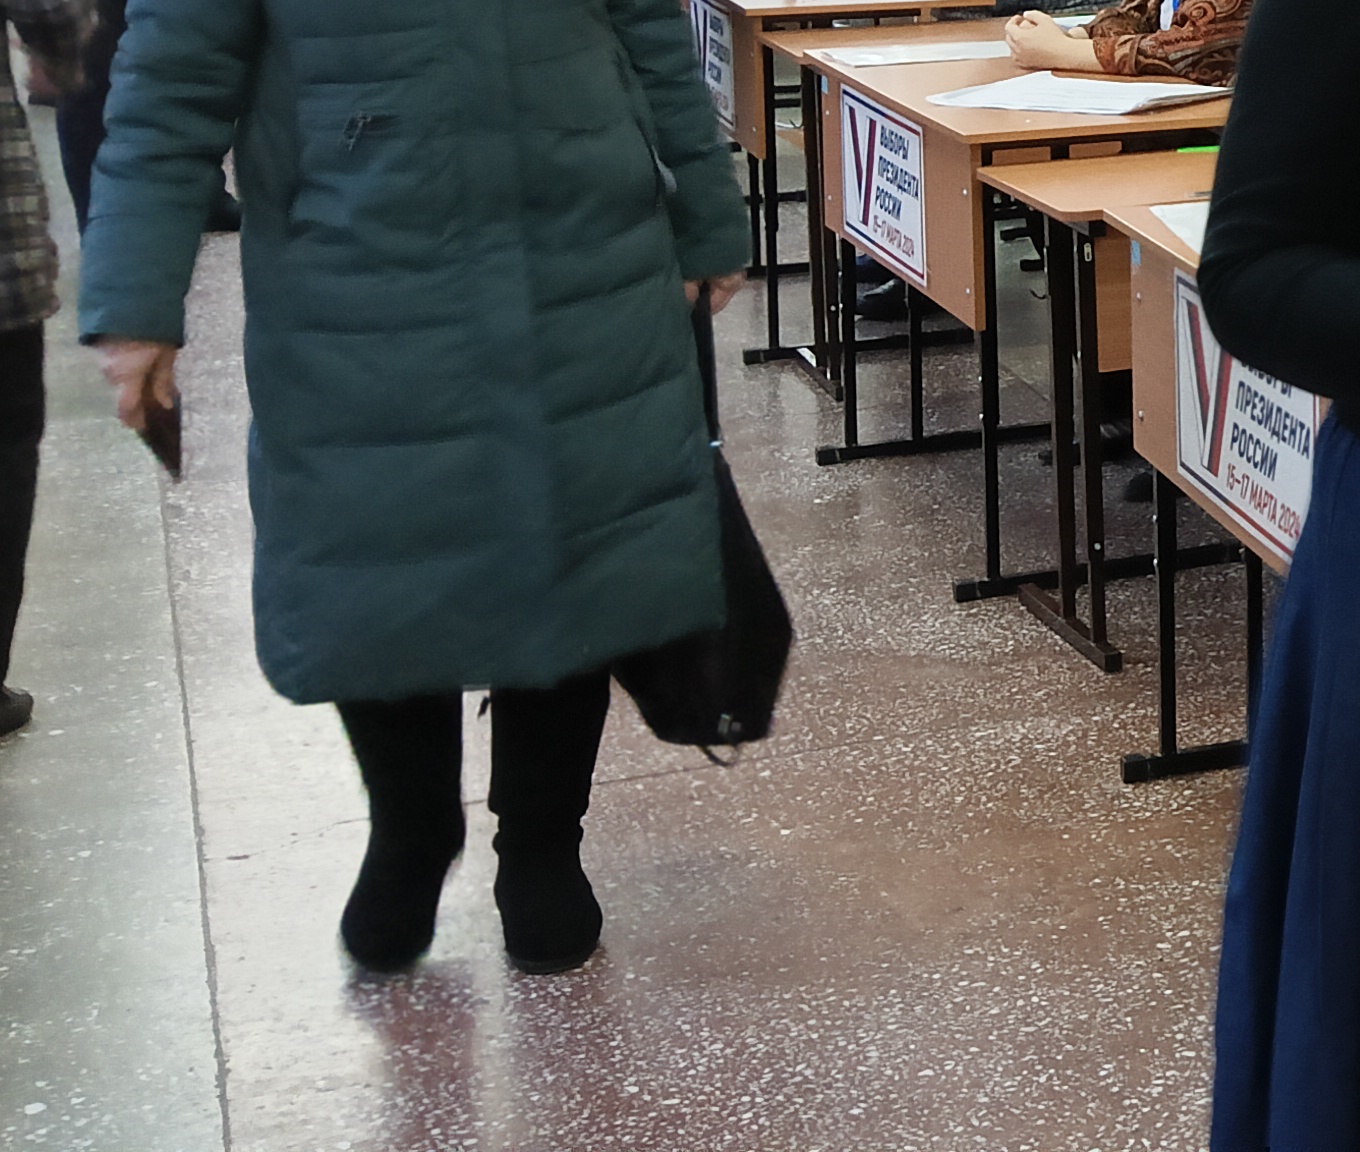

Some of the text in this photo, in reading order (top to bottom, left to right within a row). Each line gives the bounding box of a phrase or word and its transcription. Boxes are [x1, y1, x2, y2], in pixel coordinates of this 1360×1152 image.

[880, 125, 909, 161] ВЫБОРЫ
[878, 155, 919, 201] ПРЕЗИДЕНТА
[875, 185, 902, 221] РОССИИ
[1236, 381, 1311, 460] ПРЕЗИДЕНТА
[1230, 422, 1278, 482] РОССИИ
[1249, 479, 1278, 525] МАРТА
